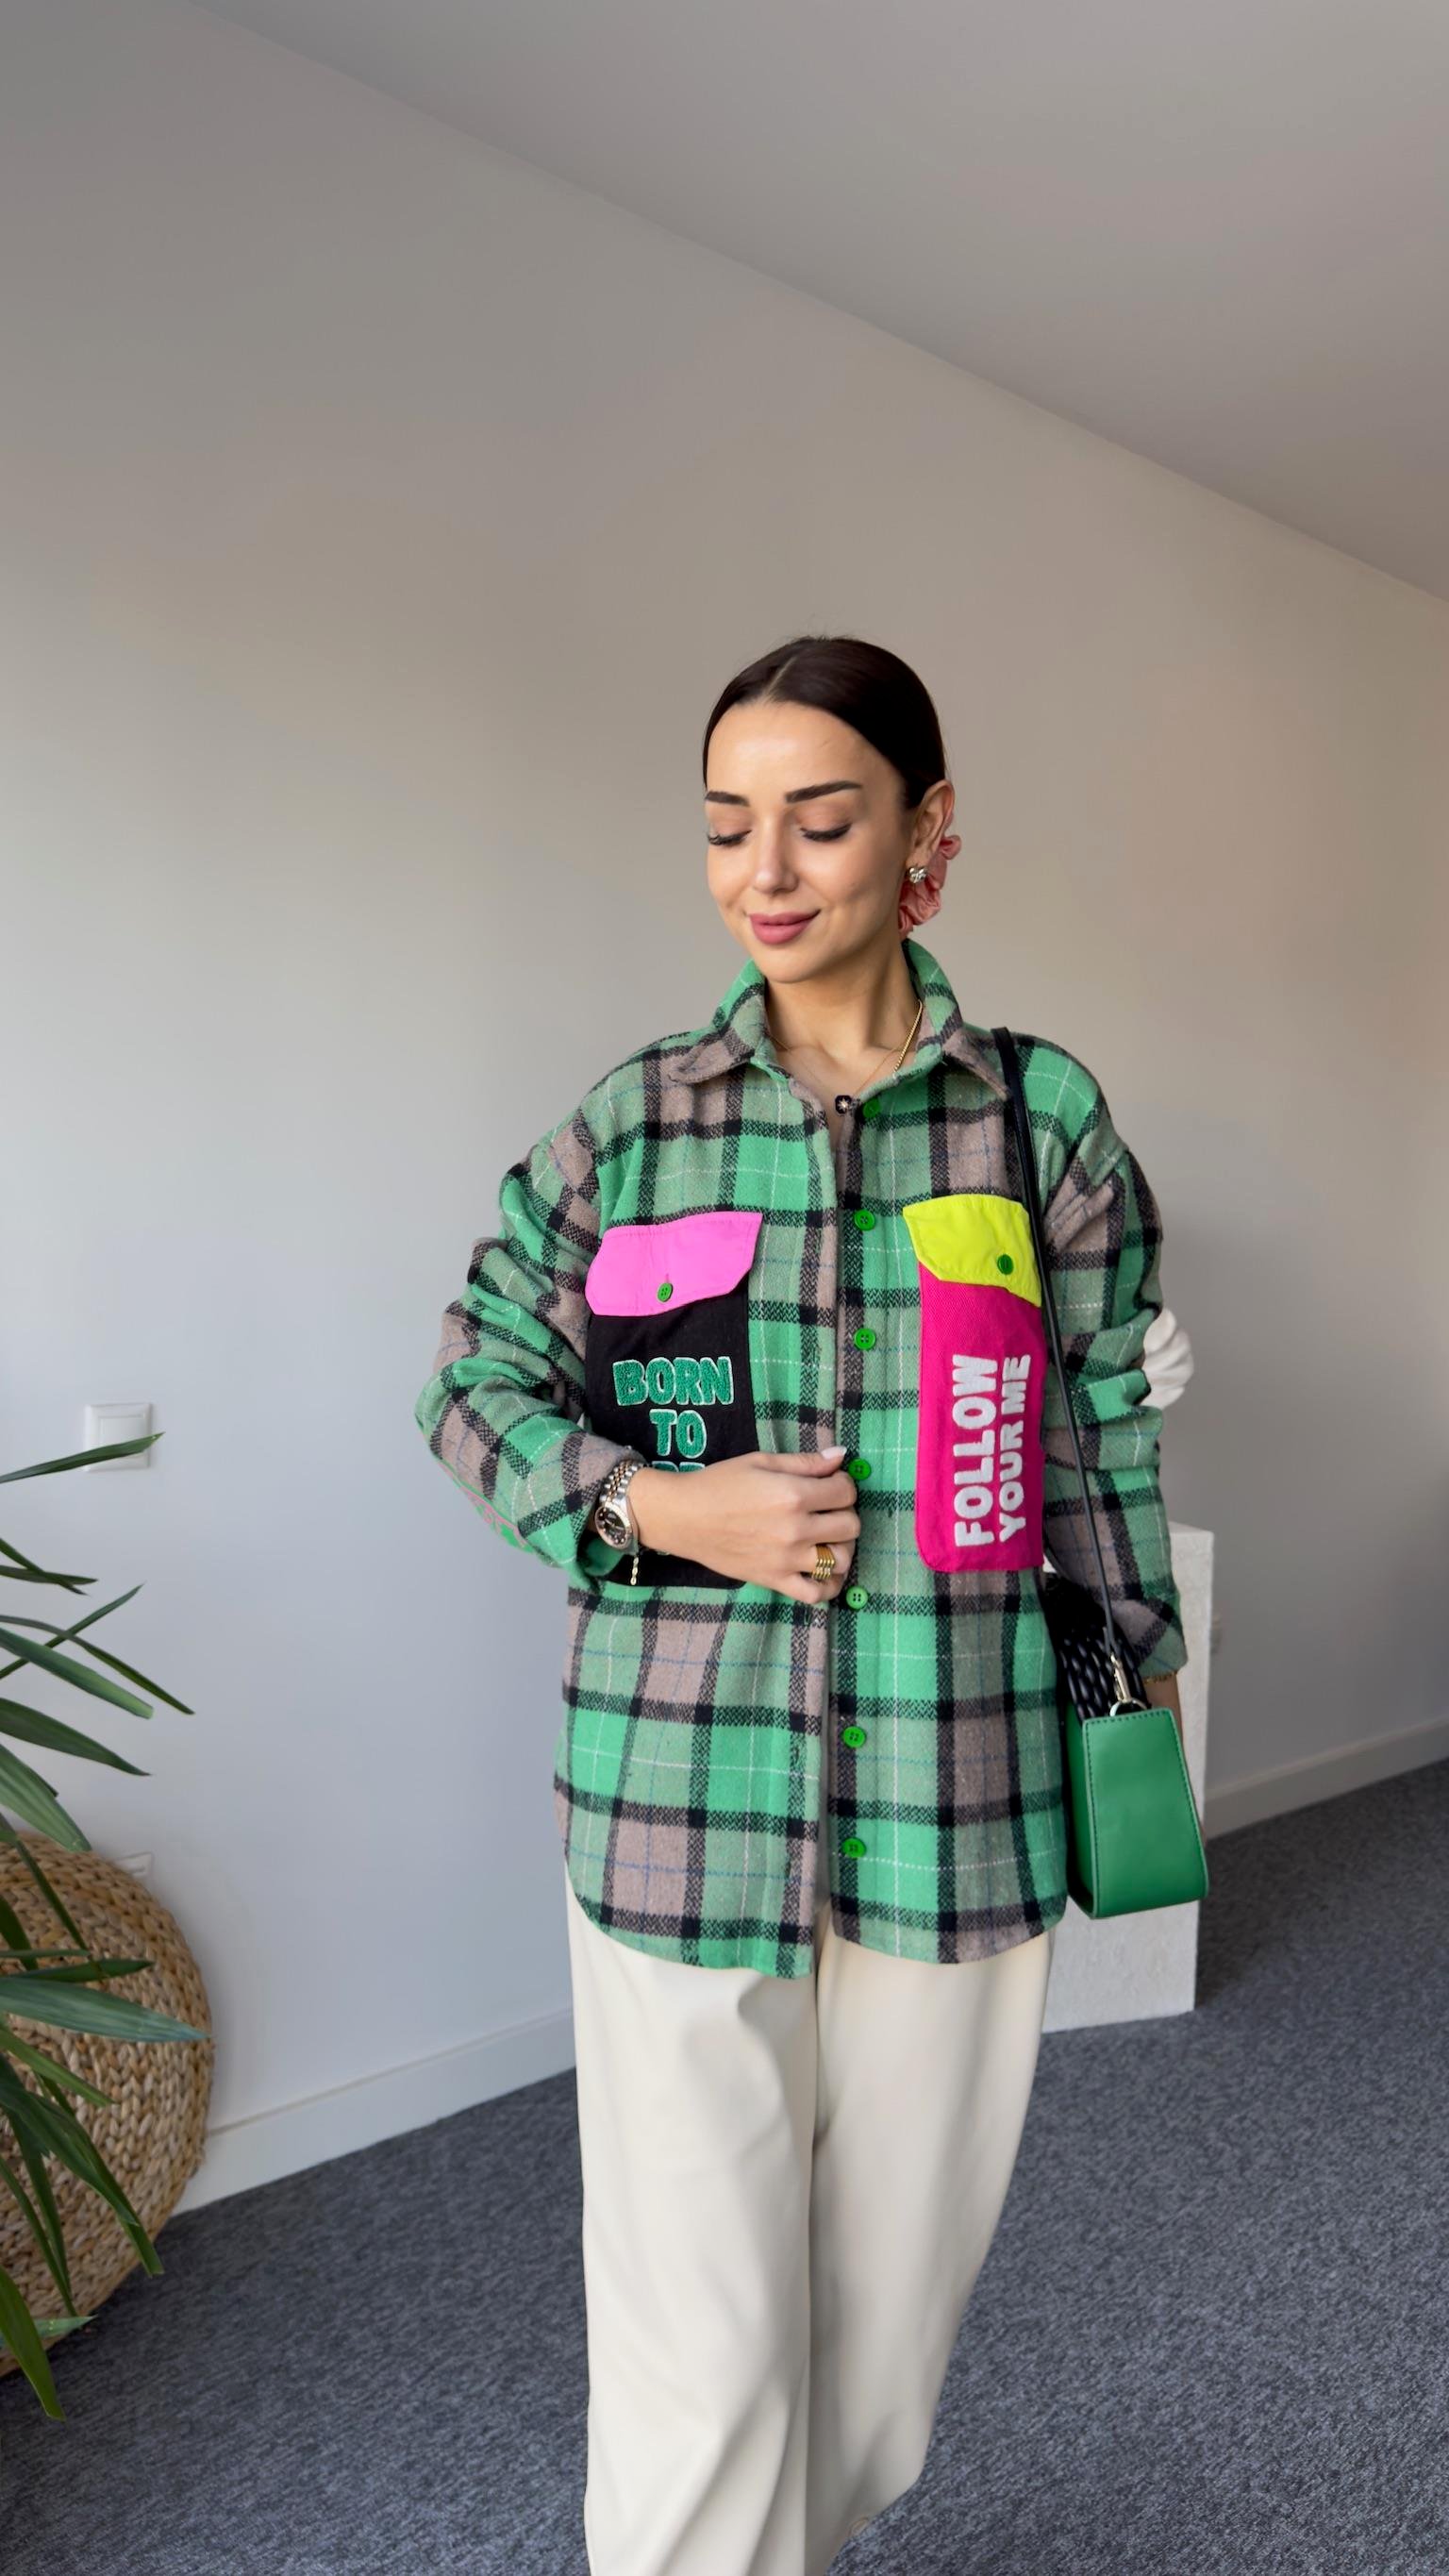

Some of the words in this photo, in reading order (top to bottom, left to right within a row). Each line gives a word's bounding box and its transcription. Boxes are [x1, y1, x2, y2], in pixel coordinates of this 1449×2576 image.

[613, 1356, 734, 1406] BORN
[1001, 1354, 1031, 1413] ME
[649, 1409, 707, 1459] TO
[952, 1354, 997, 1547] FOLLOW
[999, 1420, 1026, 1542] YOUR
